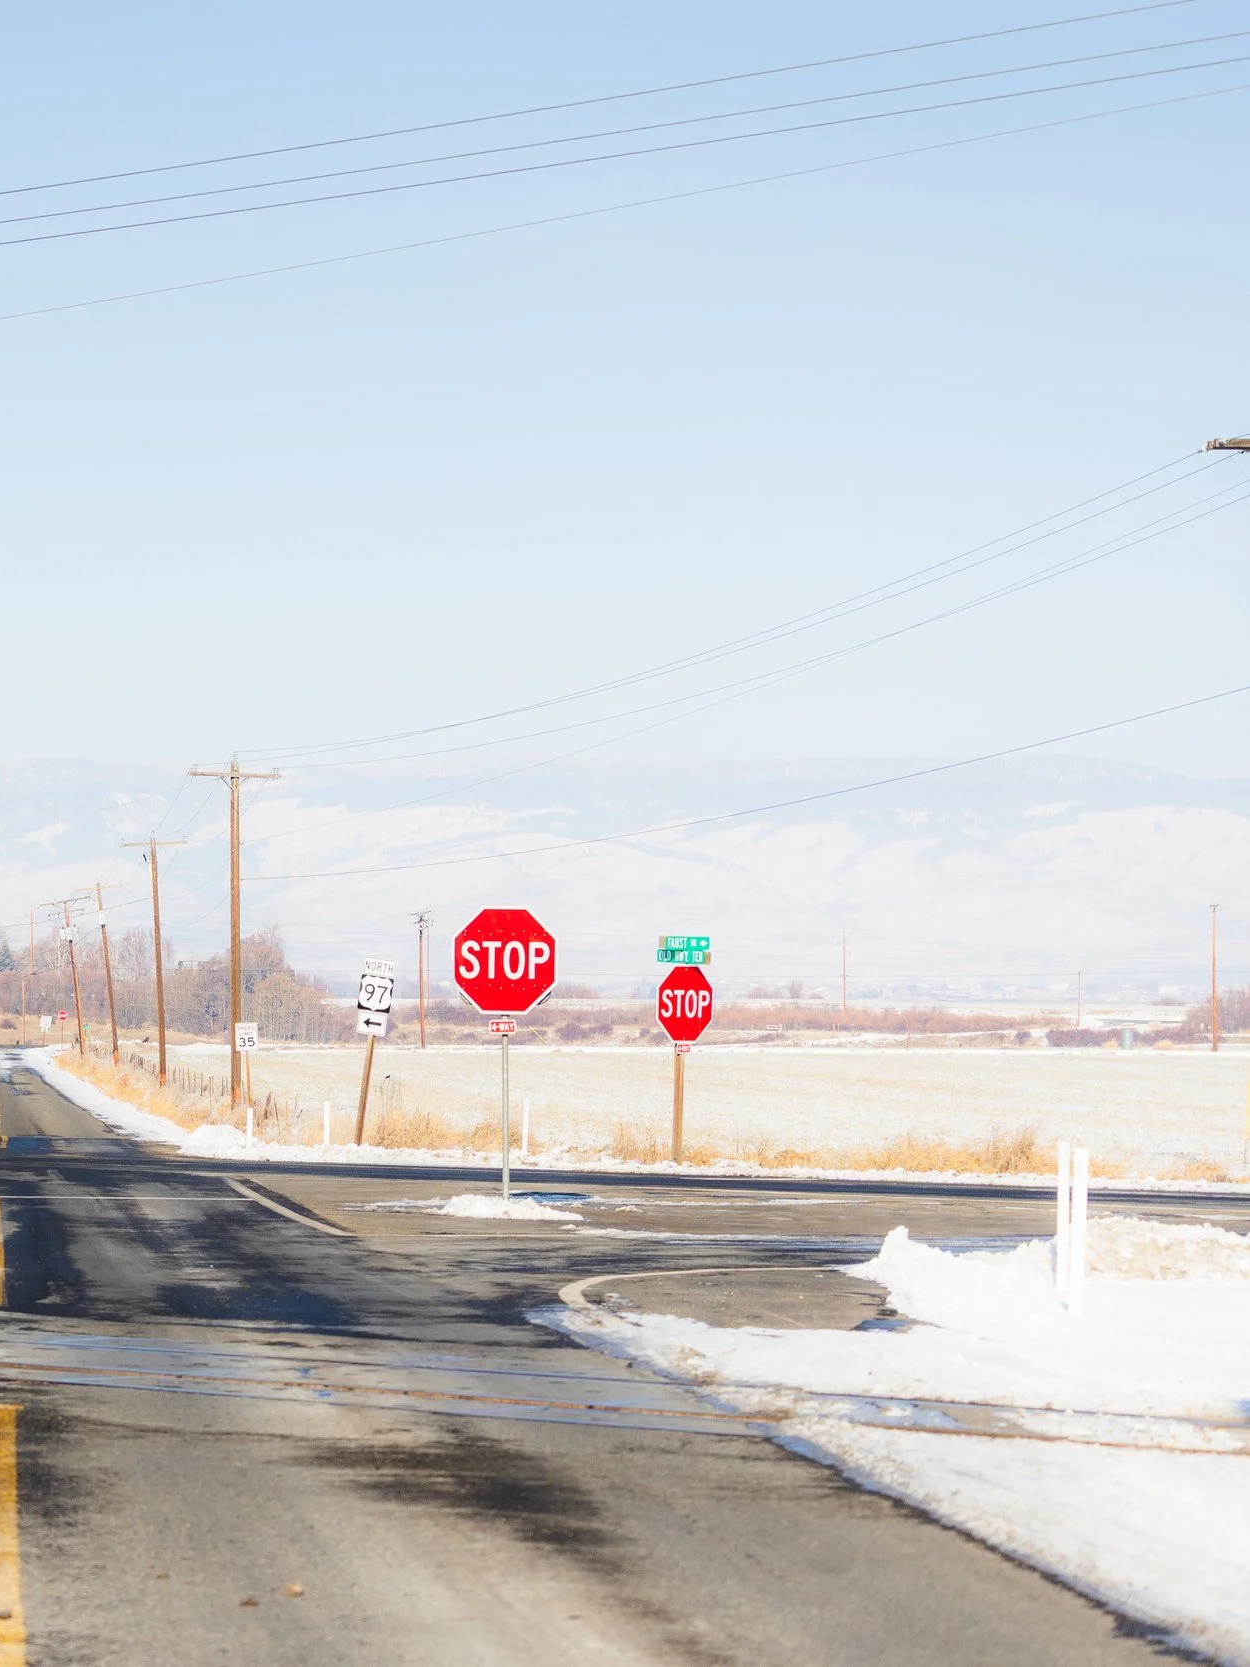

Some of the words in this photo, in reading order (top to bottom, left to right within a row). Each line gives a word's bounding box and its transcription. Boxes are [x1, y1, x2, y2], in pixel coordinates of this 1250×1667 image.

[667, 937, 688, 949] FAUST
[458, 940, 551, 981] STOP
[658, 950, 672, 962] OLD
[692, 950, 703, 963] TEN
[364, 960, 394, 974] NORTH
[364, 983, 389, 1004] 97
[661, 988, 710, 1019] STOP
[490, 1022, 515, 1032] 4-WAY
[239, 1037, 255, 1047] 35
